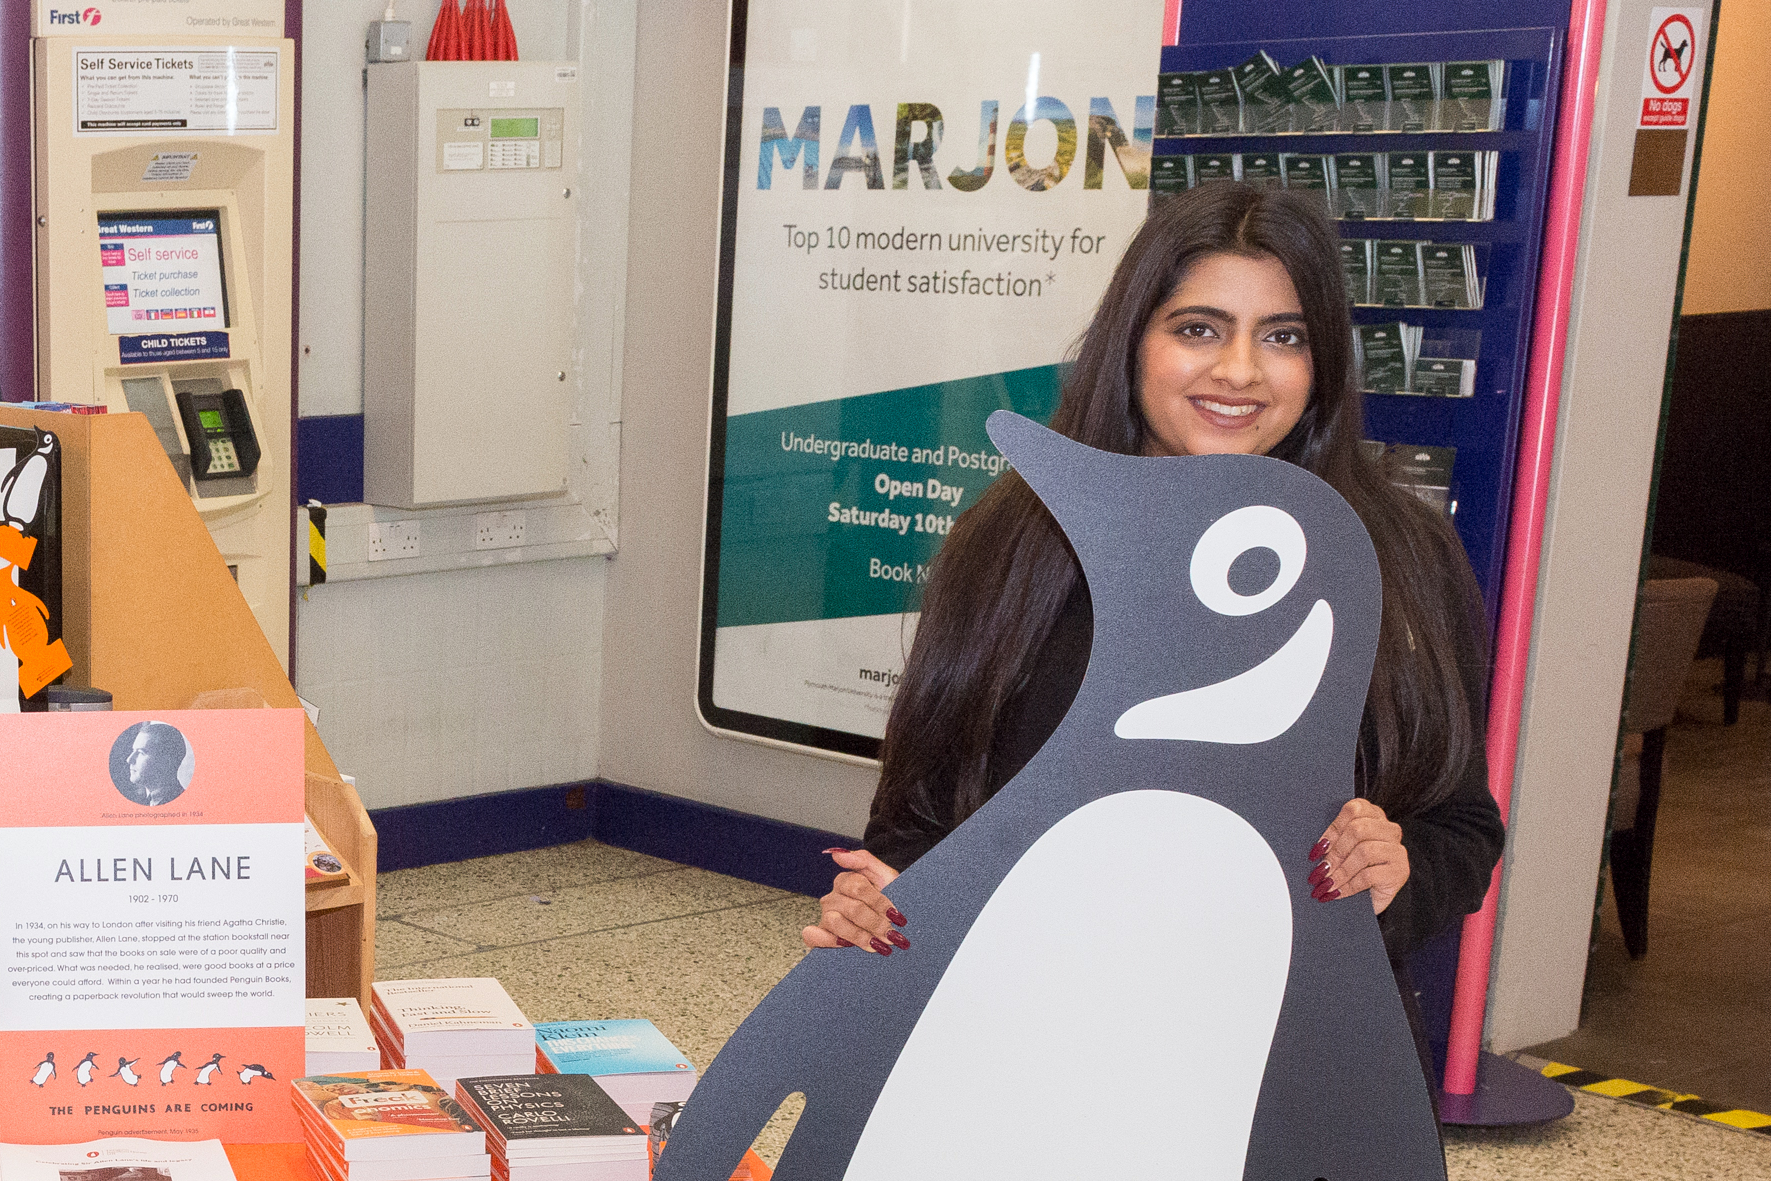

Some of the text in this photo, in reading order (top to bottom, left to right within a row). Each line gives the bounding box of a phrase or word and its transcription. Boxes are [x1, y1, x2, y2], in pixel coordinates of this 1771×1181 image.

[50, 10, 80, 24] First
[186, 17, 276, 27] Operated by Great Western
[80, 58, 105, 70] Self
[108, 58, 152, 70] Service
[154, 58, 194, 69] Tickets
[1649, 100, 1682, 114] No dogs
[755, 95, 1156, 192] MARJON
[119, 224, 153, 233] Western
[783, 224, 1106, 260] Top 10 modern university for
[128, 248, 151, 262] Self
[156, 248, 198, 260] service
[132, 270, 198, 282] Ticket purchase
[819, 267, 902, 293] student
[133, 288, 158, 298] Ticket
[161, 287, 200, 297] collection
[141, 337, 206, 348] CHILD TICKETS
[781, 432, 908, 462] Undergraduate
[912, 446, 944, 465] and
[874, 474, 964, 507] Open Day
[828, 502, 910, 535] Saturday
[869, 558, 912, 582] Book
[134, 811, 181, 820] photographed
[189, 810, 204, 818] 1934
[54, 856, 250, 883] ALLEN LANE
[129, 894, 149, 904] 1902
[158, 894, 179, 903] 1970
[25, 921, 46, 930] 1934,
[101, 921, 134, 929] London
[134, 920, 154, 928] after
[155, 920, 183, 930] visiting
[197, 919, 222, 927] friend
[222, 919, 254, 929] Agatha
[254, 918, 288, 926] Christie,
[7, 964, 56, 974] over-priced.
[56, 964, 78, 972] What
[97, 964, 132, 972] needed,
[146, 963, 181, 971] realised,
[203, 962, 227, 972] good
[228, 962, 254, 970] books
[255, 961, 265, 969] at
[273, 960, 296, 970] price
[400, 1005, 466, 1013] Thinking,
[537, 1025, 607, 1034] Naomi
[540, 1032, 598, 1040] Klein
[474, 1082, 530, 1091] SEVEN
[478, 1088, 521, 1096] BRIEF
[482, 1091, 562, 1101] LESSONS
[49, 1102, 254, 1116] THE PENGUINS ARE COMING
[491, 1102, 564, 1112] PHYSICS
[498, 1110, 557, 1119] CARLO
[503, 1116, 571, 1125] ROVELLI
[97, 1129, 123, 1138] Penguin
[124, 1129, 168, 1137] advertisement,
[169, 1128, 184, 1136] May
